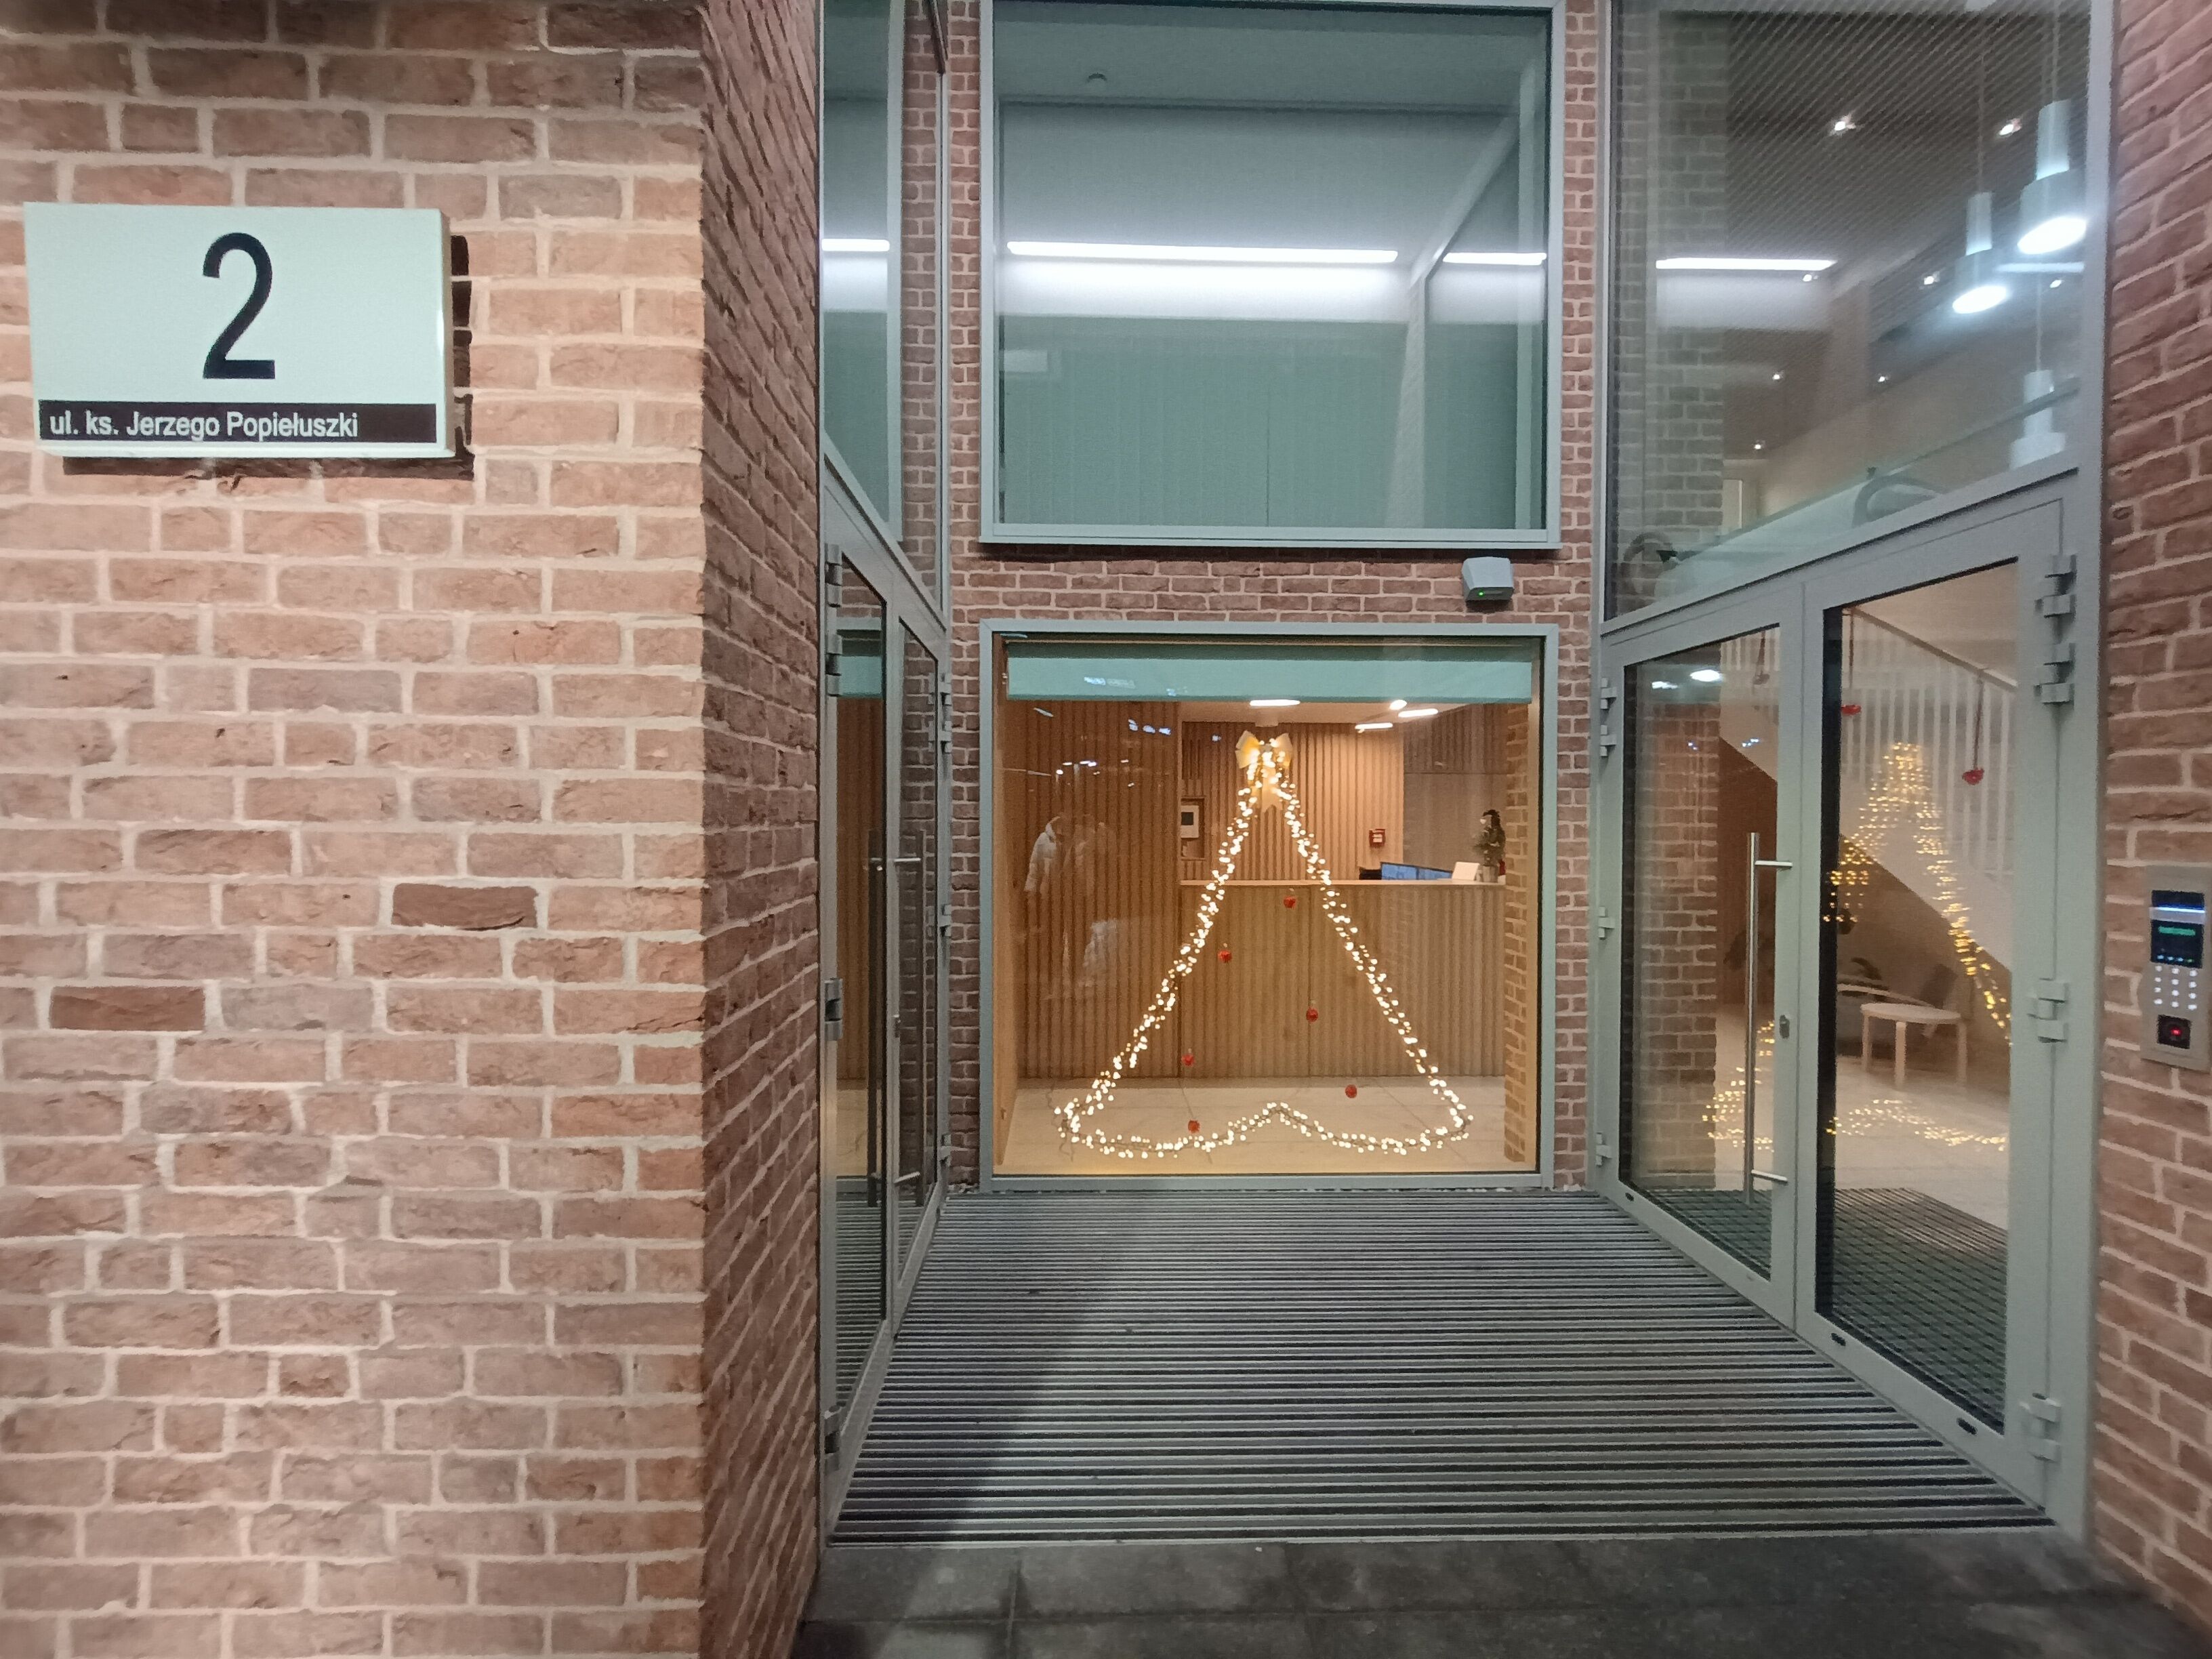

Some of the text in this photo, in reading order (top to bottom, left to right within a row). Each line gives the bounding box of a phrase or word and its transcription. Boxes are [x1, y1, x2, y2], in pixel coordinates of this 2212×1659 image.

[203, 232, 275, 380] 2
[49, 409, 359, 441] ul. ks. Jerzego Popiełuszki
